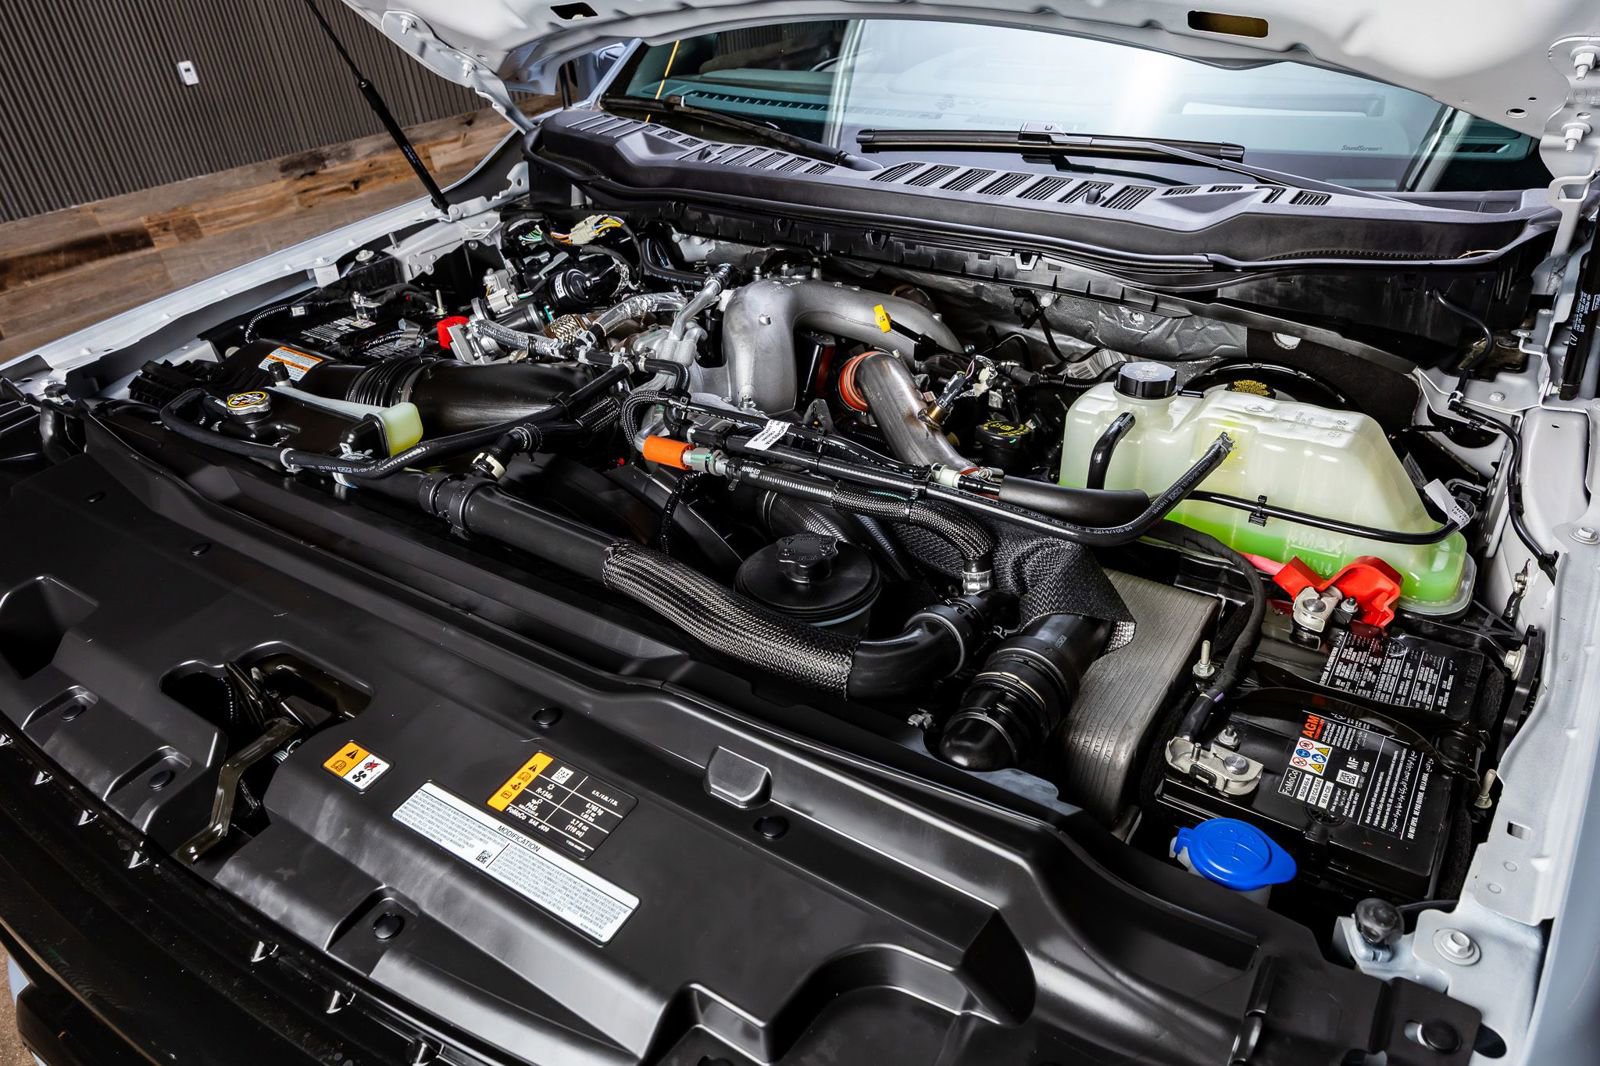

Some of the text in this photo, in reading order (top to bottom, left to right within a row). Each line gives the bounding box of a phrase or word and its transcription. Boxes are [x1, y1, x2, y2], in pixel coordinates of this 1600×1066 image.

[1302, 715, 1320, 737] AGM
[1346, 757, 1359, 770] MF
[1282, 770, 1298, 795] FoMoCo
[506, 806, 528, 821] FoMoCo
[496, 826, 541, 852] MODIFICATION
